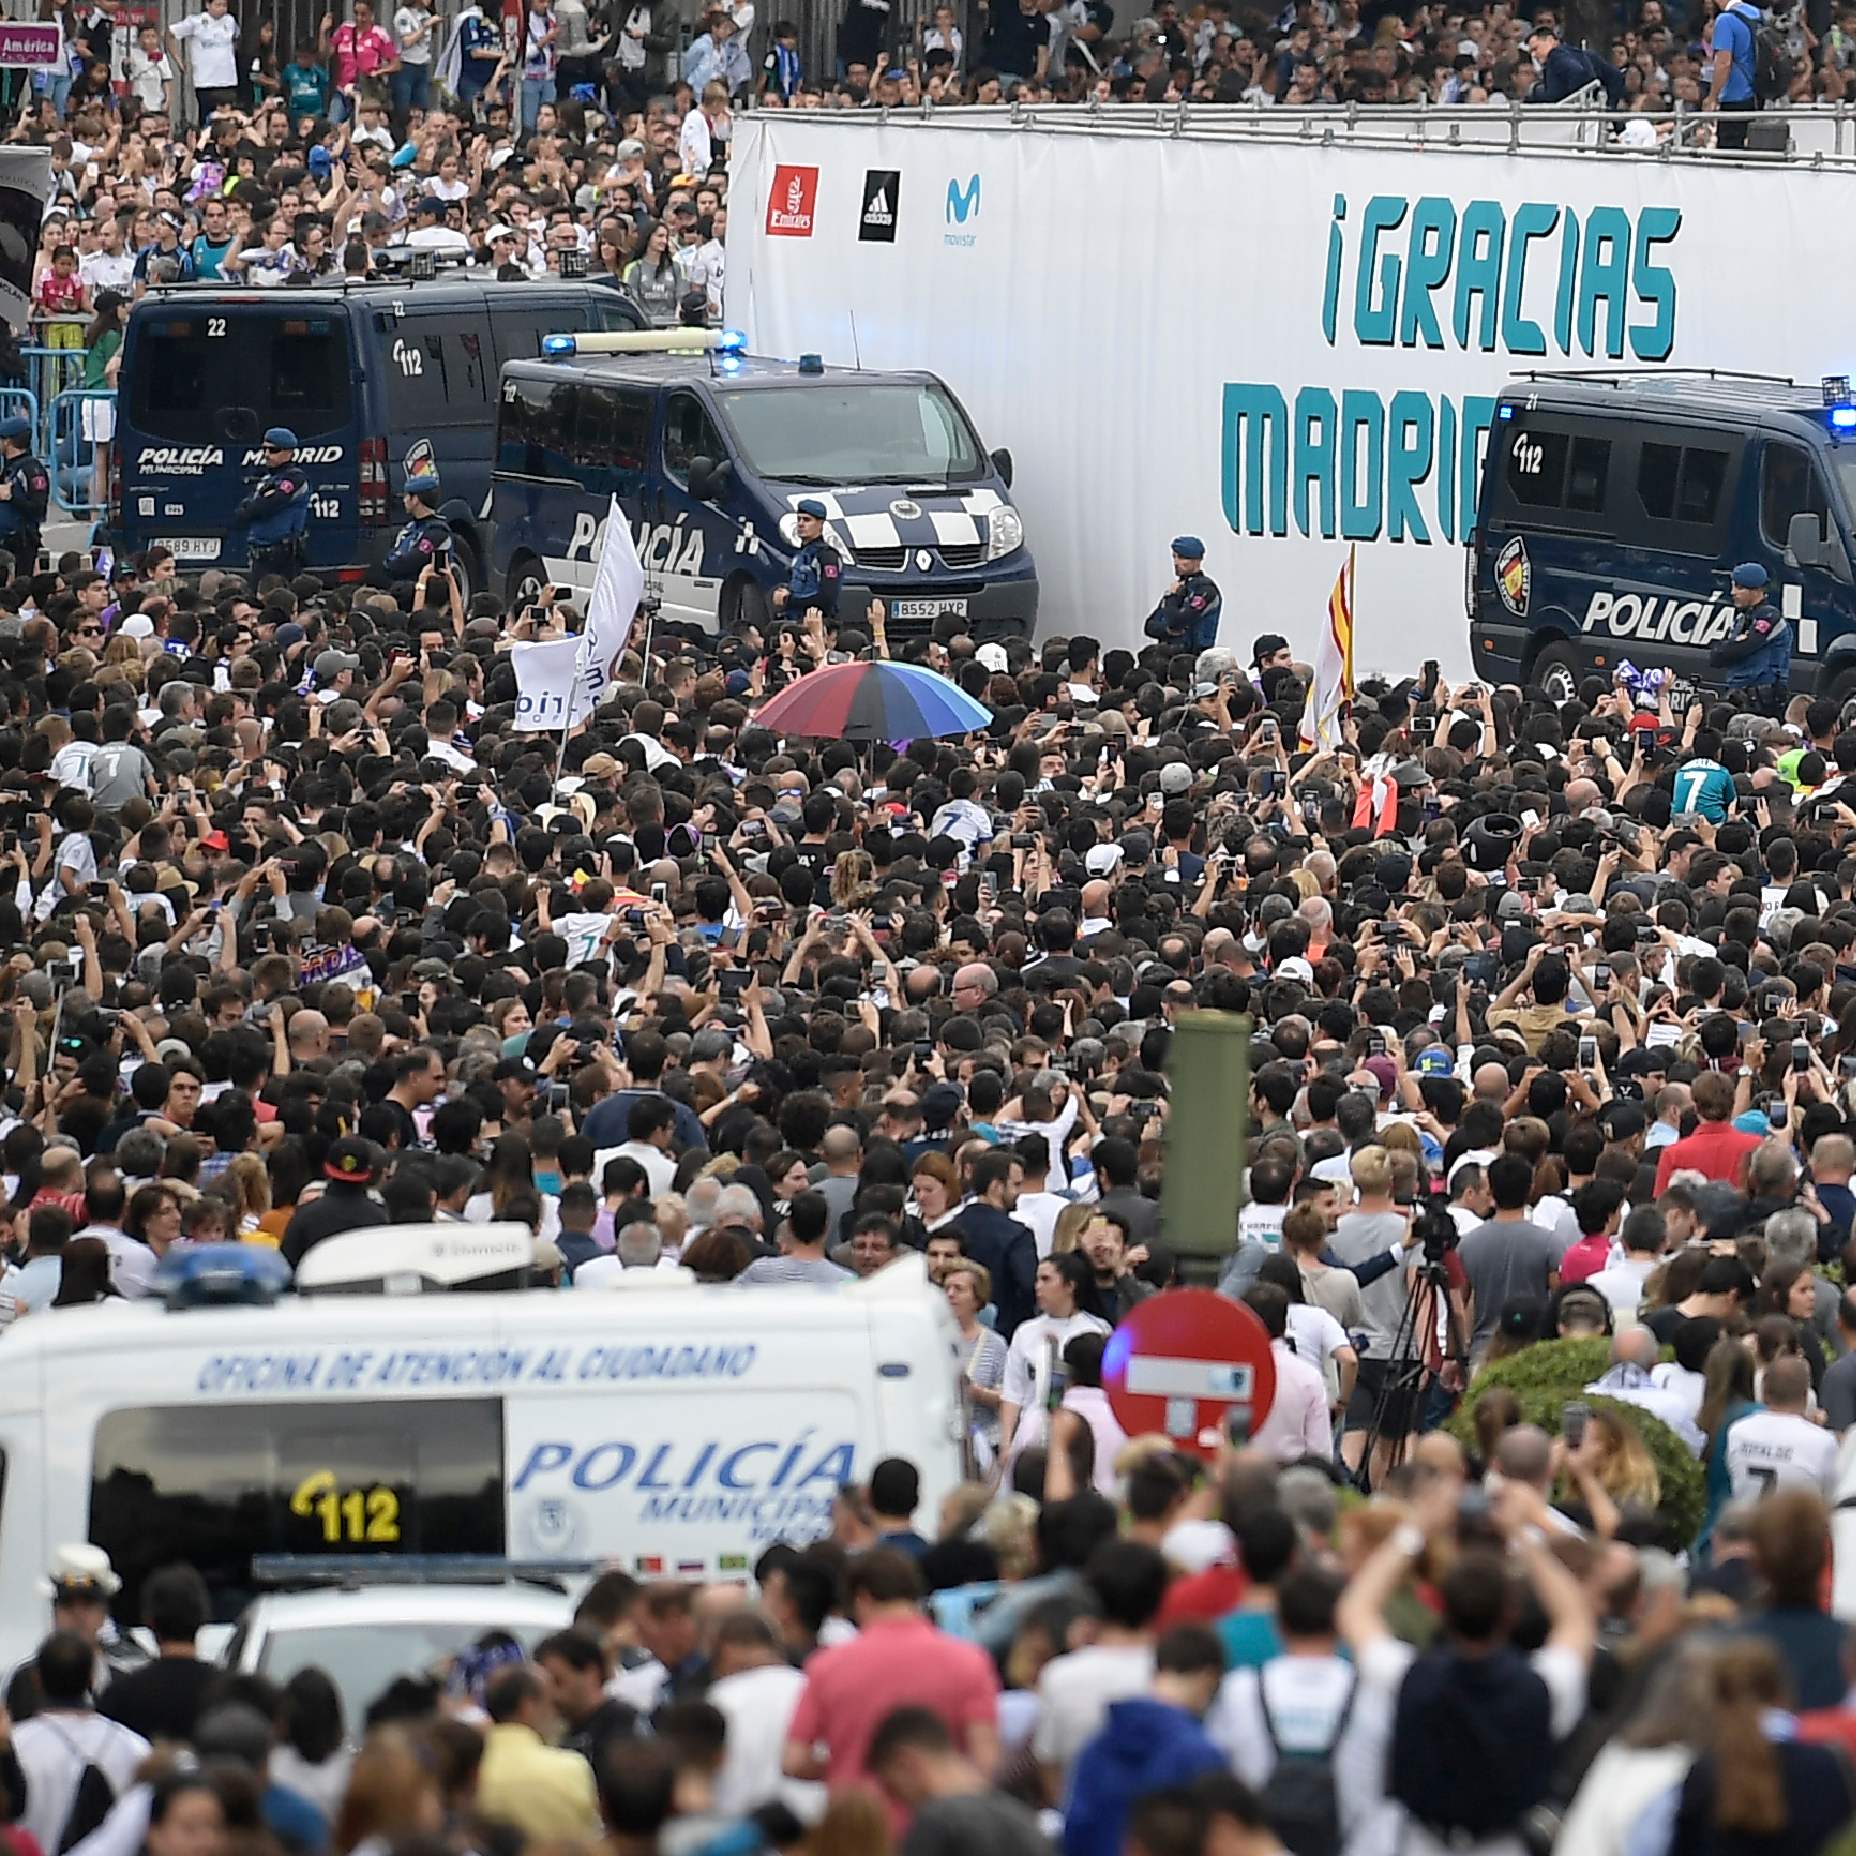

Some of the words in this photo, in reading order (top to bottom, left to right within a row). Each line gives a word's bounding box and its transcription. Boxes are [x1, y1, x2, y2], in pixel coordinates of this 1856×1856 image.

[3, 37, 55, 54] América
[208, 318, 226, 337] 22
[401, 349, 423, 377] 112
[137, 445, 223, 465] POLICÍA
[242, 445, 344, 466] MRID
[1518, 445, 1544, 474] 112
[566, 512, 705, 577] PICÍA
[901, 600, 936, 616] 8552
[1581, 590, 1737, 646] POLICÍA
[1682, 770, 1707, 815] 7
[942, 812, 962, 834] 7
[581, 936, 597, 958] 7
[197, 1356, 322, 1392] OFICINA
[326, 1353, 374, 1389] DE
[376, 1346, 530, 1387] ATENCIÓN
[531, 1349, 573, 1384] AL
[577, 1345, 757, 1382] CIUDADANO
[513, 1426, 858, 1492] POLICÍA
[317, 1489, 402, 1542] 112
[638, 1496, 835, 1523] MUNICIPA
